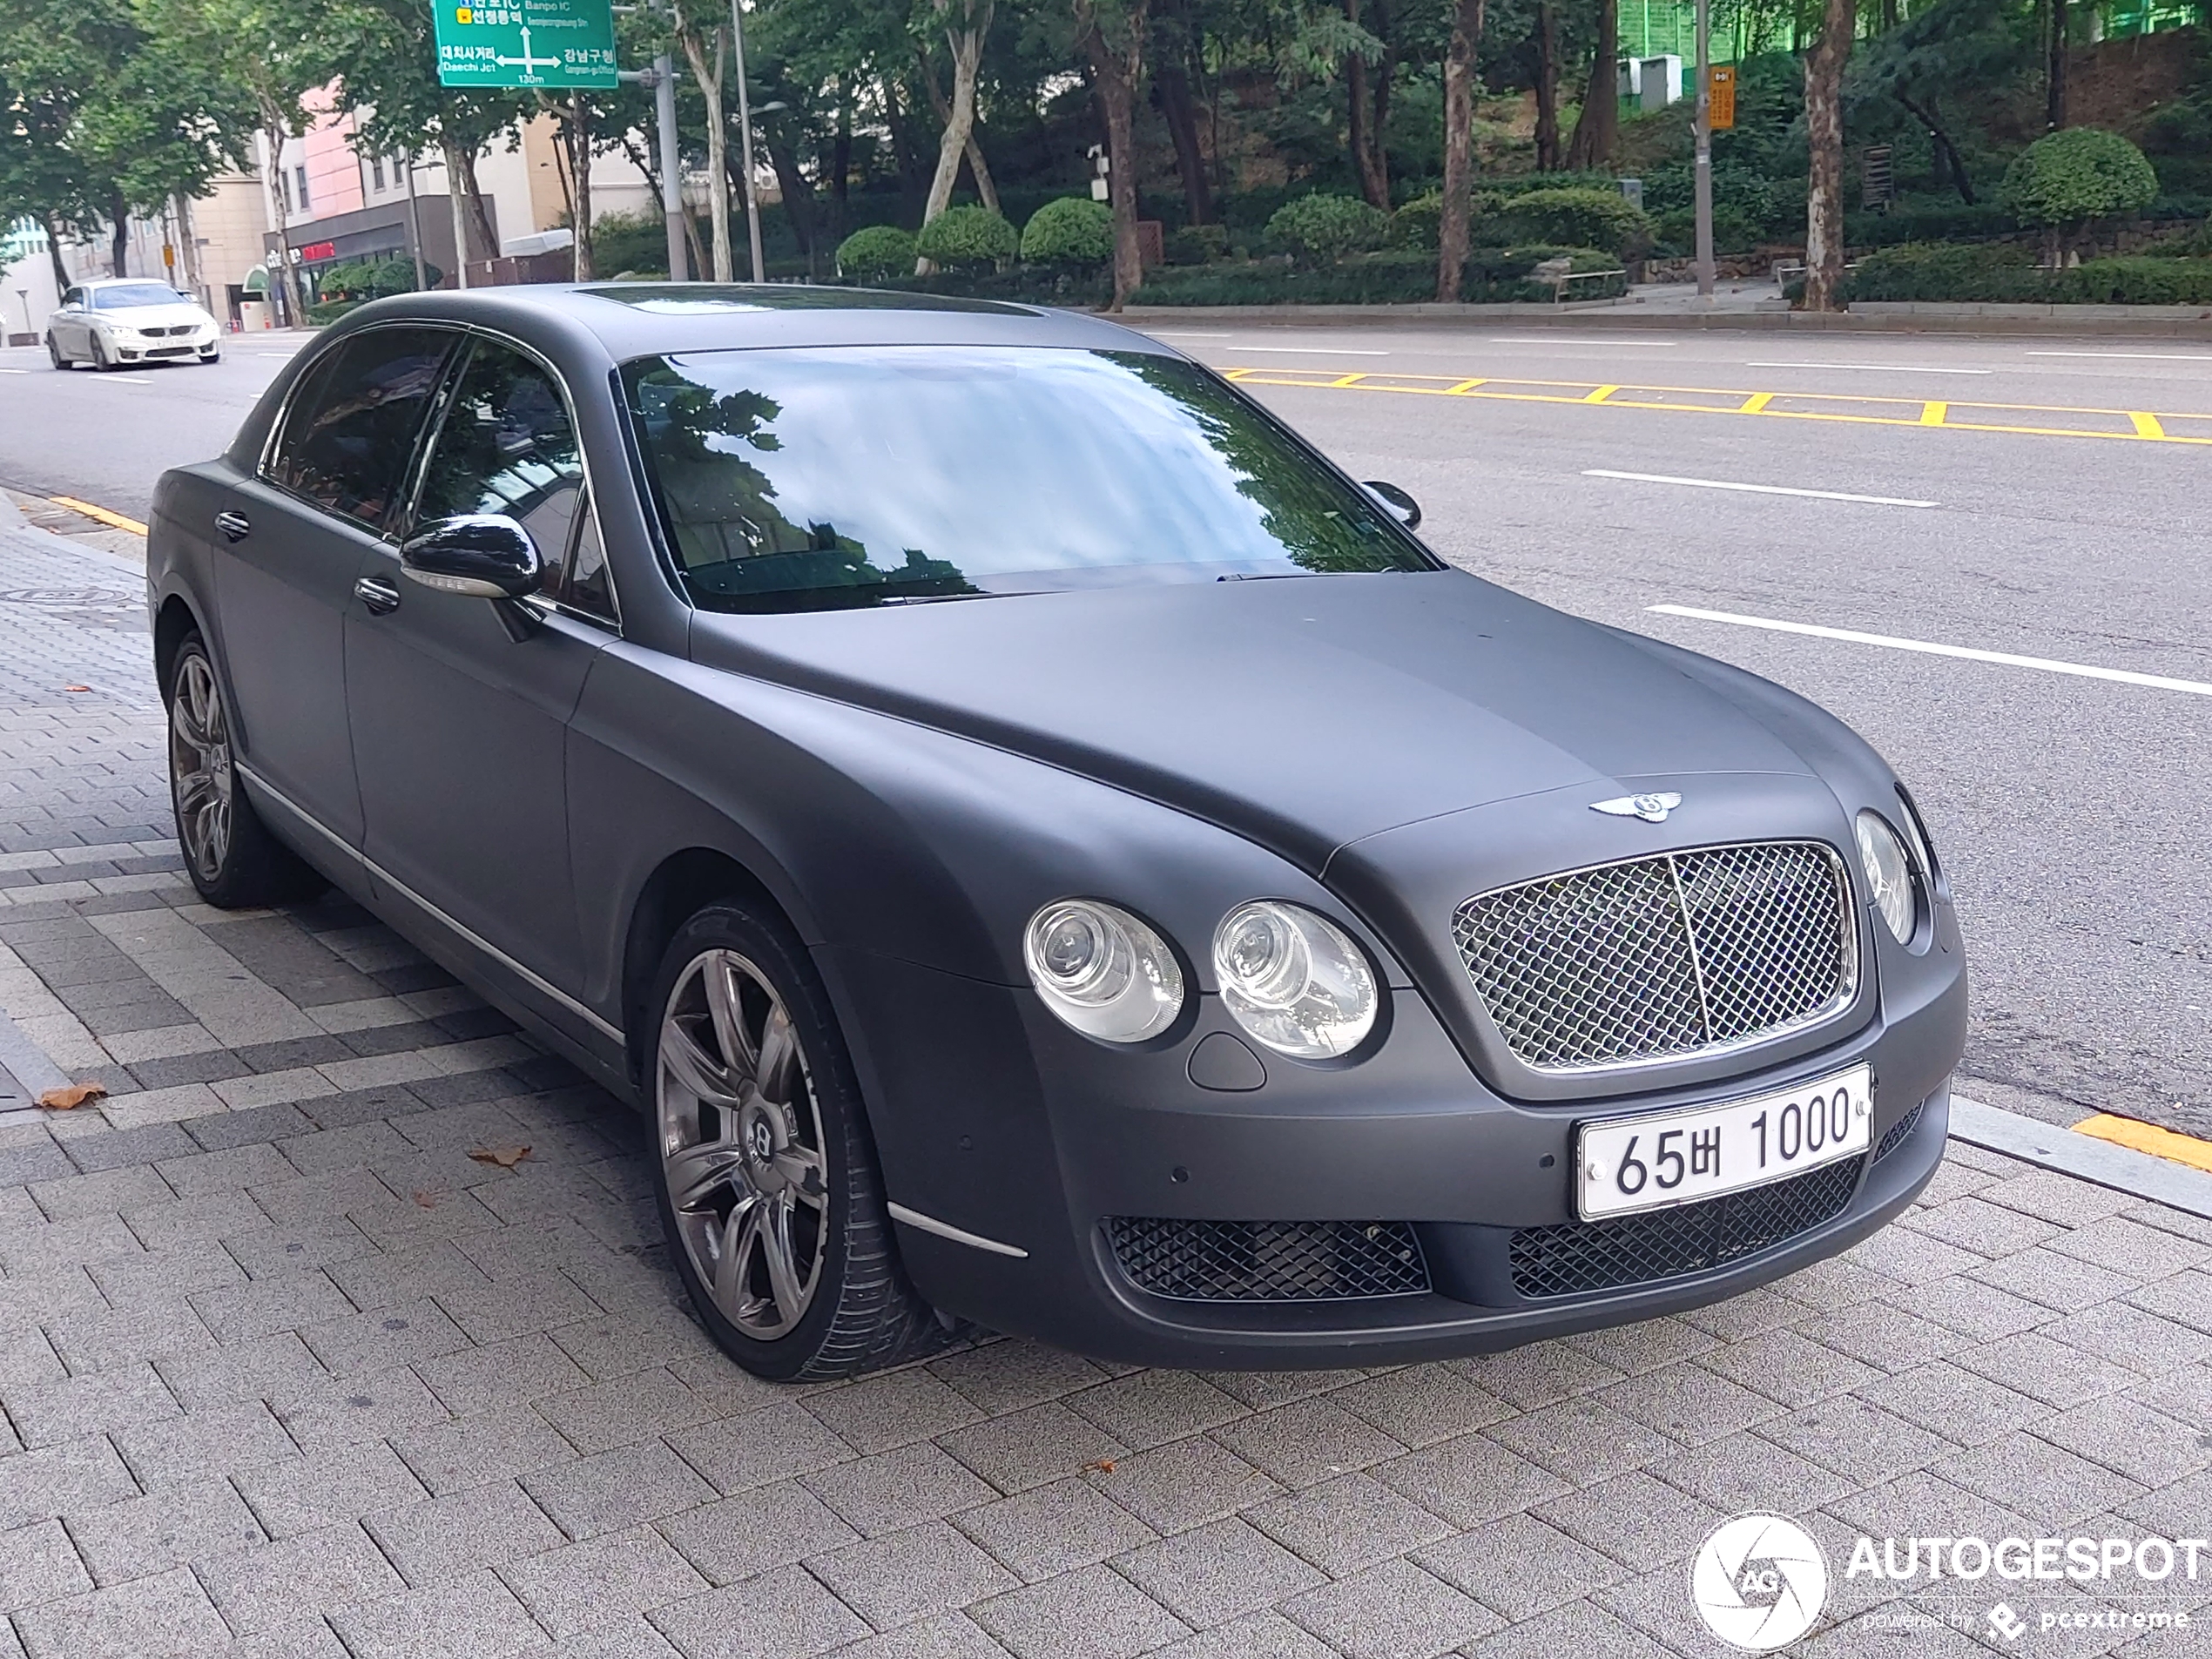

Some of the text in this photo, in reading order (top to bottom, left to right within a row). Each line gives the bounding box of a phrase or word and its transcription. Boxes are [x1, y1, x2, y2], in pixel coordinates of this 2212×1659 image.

[441, 45, 496, 61] 대치사거리
[563, 48, 615, 64] 강남구청
[442, 61, 496, 73] Daechi Jct
[518, 74, 545, 84] 130m
[1616, 1086, 1849, 1196] 65버 1000
